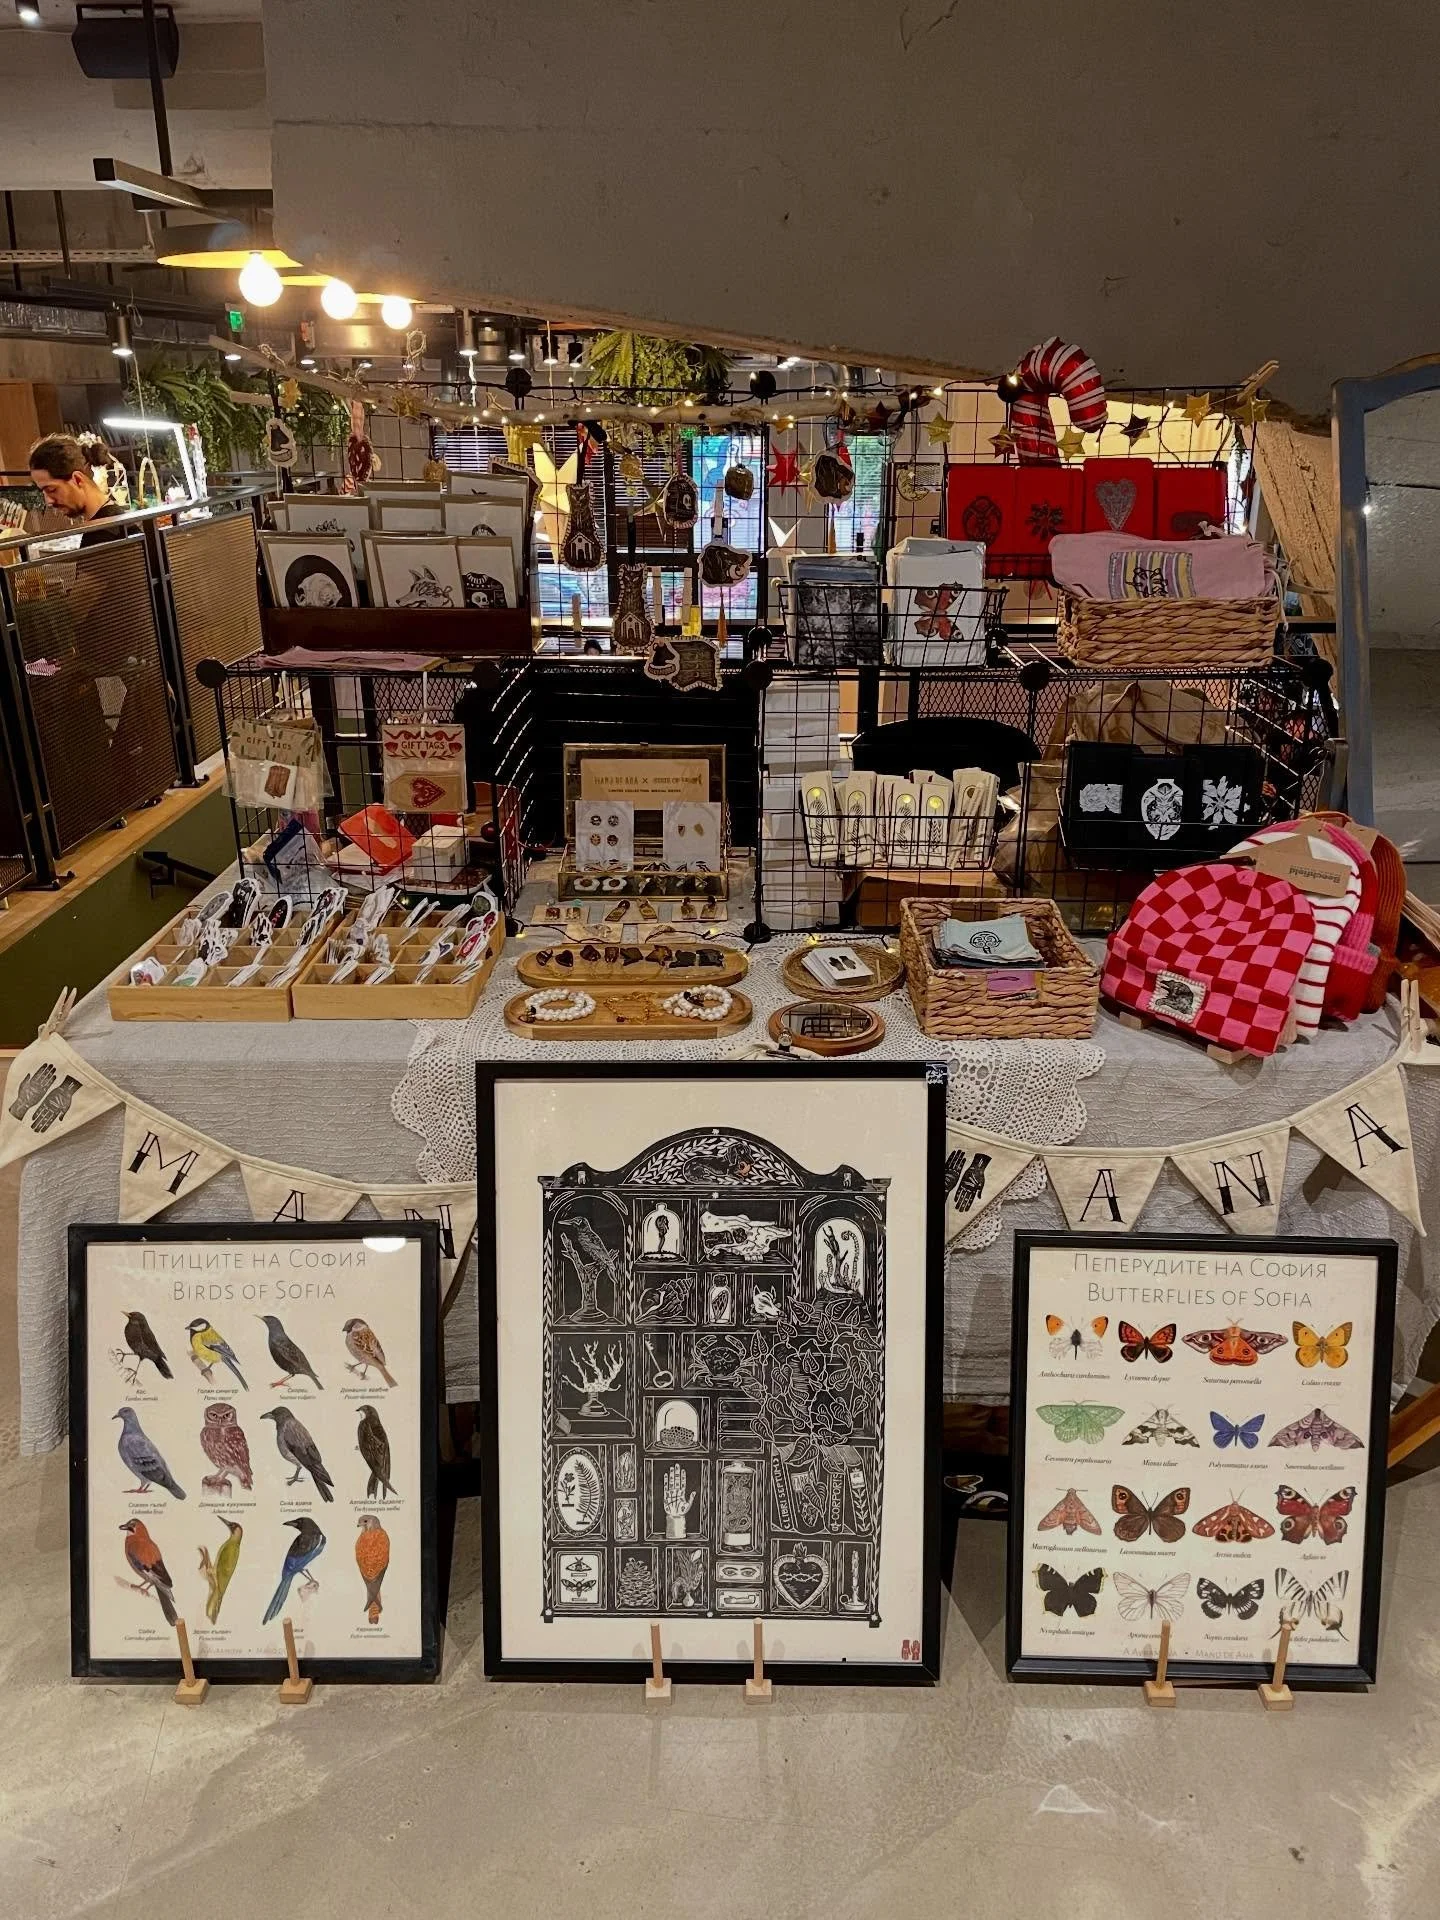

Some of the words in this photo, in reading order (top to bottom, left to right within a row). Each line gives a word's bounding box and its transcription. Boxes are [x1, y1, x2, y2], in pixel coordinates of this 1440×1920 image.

[401, 740, 422, 750] GIFT
[424, 740, 445, 750] TAGS
[1289, 867, 1341, 884] Beechfield
[253, 1252, 282, 1270] НА
[1215, 1260, 1243, 1278] НА
[173, 1280, 234, 1301] BIRDS
[242, 1282, 268, 1300] OF
[275, 1279, 336, 1300] SOFIA
[1088, 1281, 1216, 1306] BUTTERFLIES
[1222, 1288, 1248, 1307] OF
[1254, 1286, 1313, 1308] SOFIA
[773, 1463, 787, 1498] SEPTUM
[831, 1473, 842, 1520] CORPORIS
[779, 1499, 791, 1524] LIBRI
